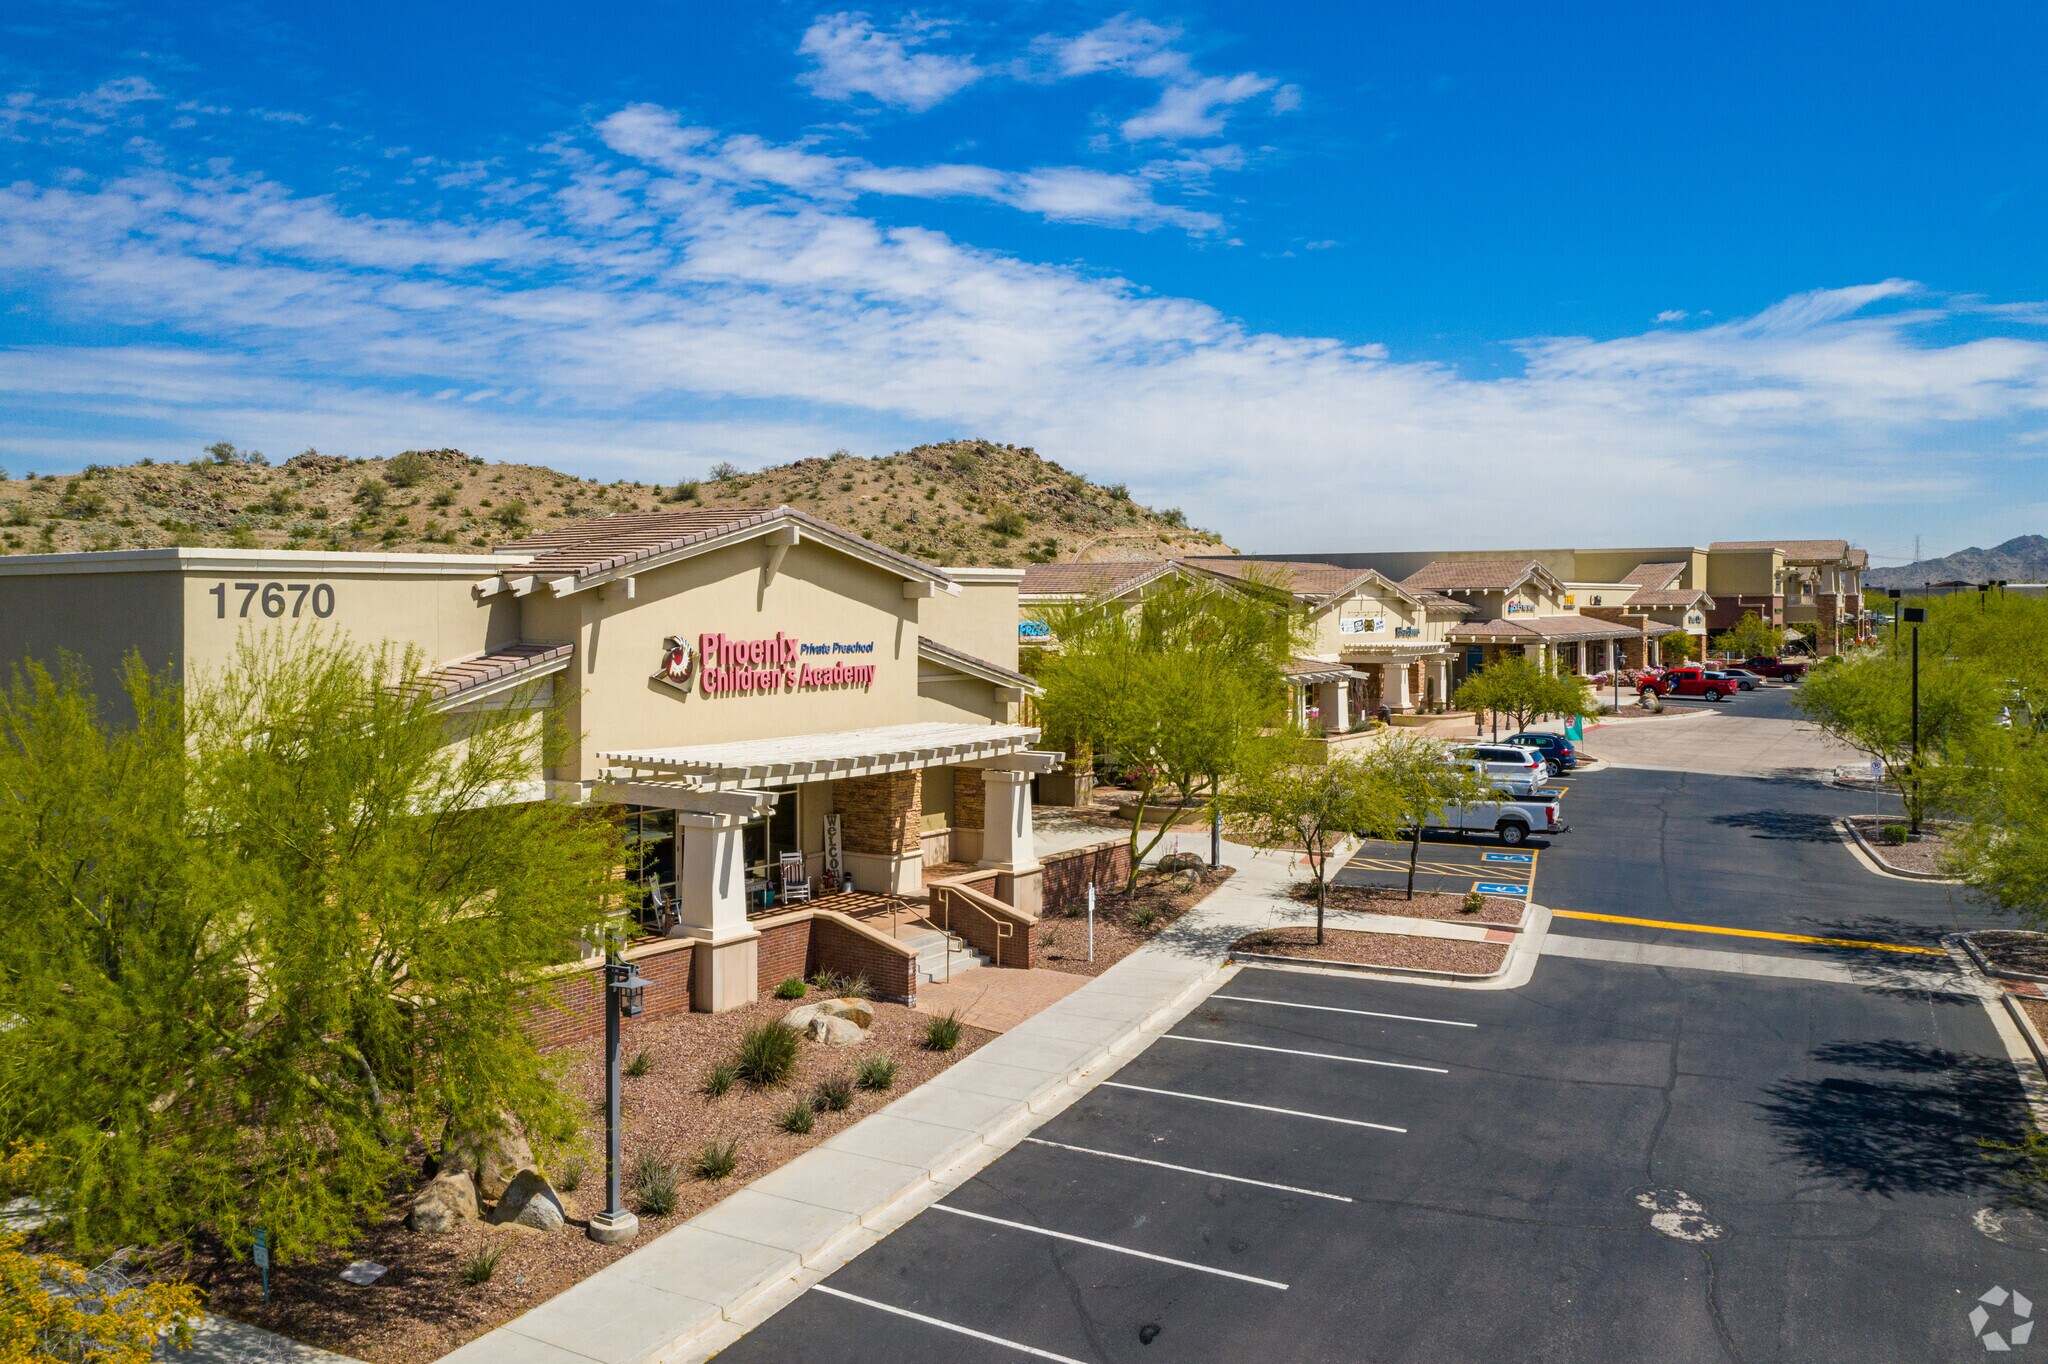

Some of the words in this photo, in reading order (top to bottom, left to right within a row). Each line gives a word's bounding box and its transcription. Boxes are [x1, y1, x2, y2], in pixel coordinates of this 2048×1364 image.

[209, 582, 335, 618] 17670
[700, 631, 799, 666] Phoenix
[801, 643, 830, 656] Private
[832, 641, 874, 654] Preschool
[701, 664, 798, 693] Children's
[800, 661, 876, 688] Academy
